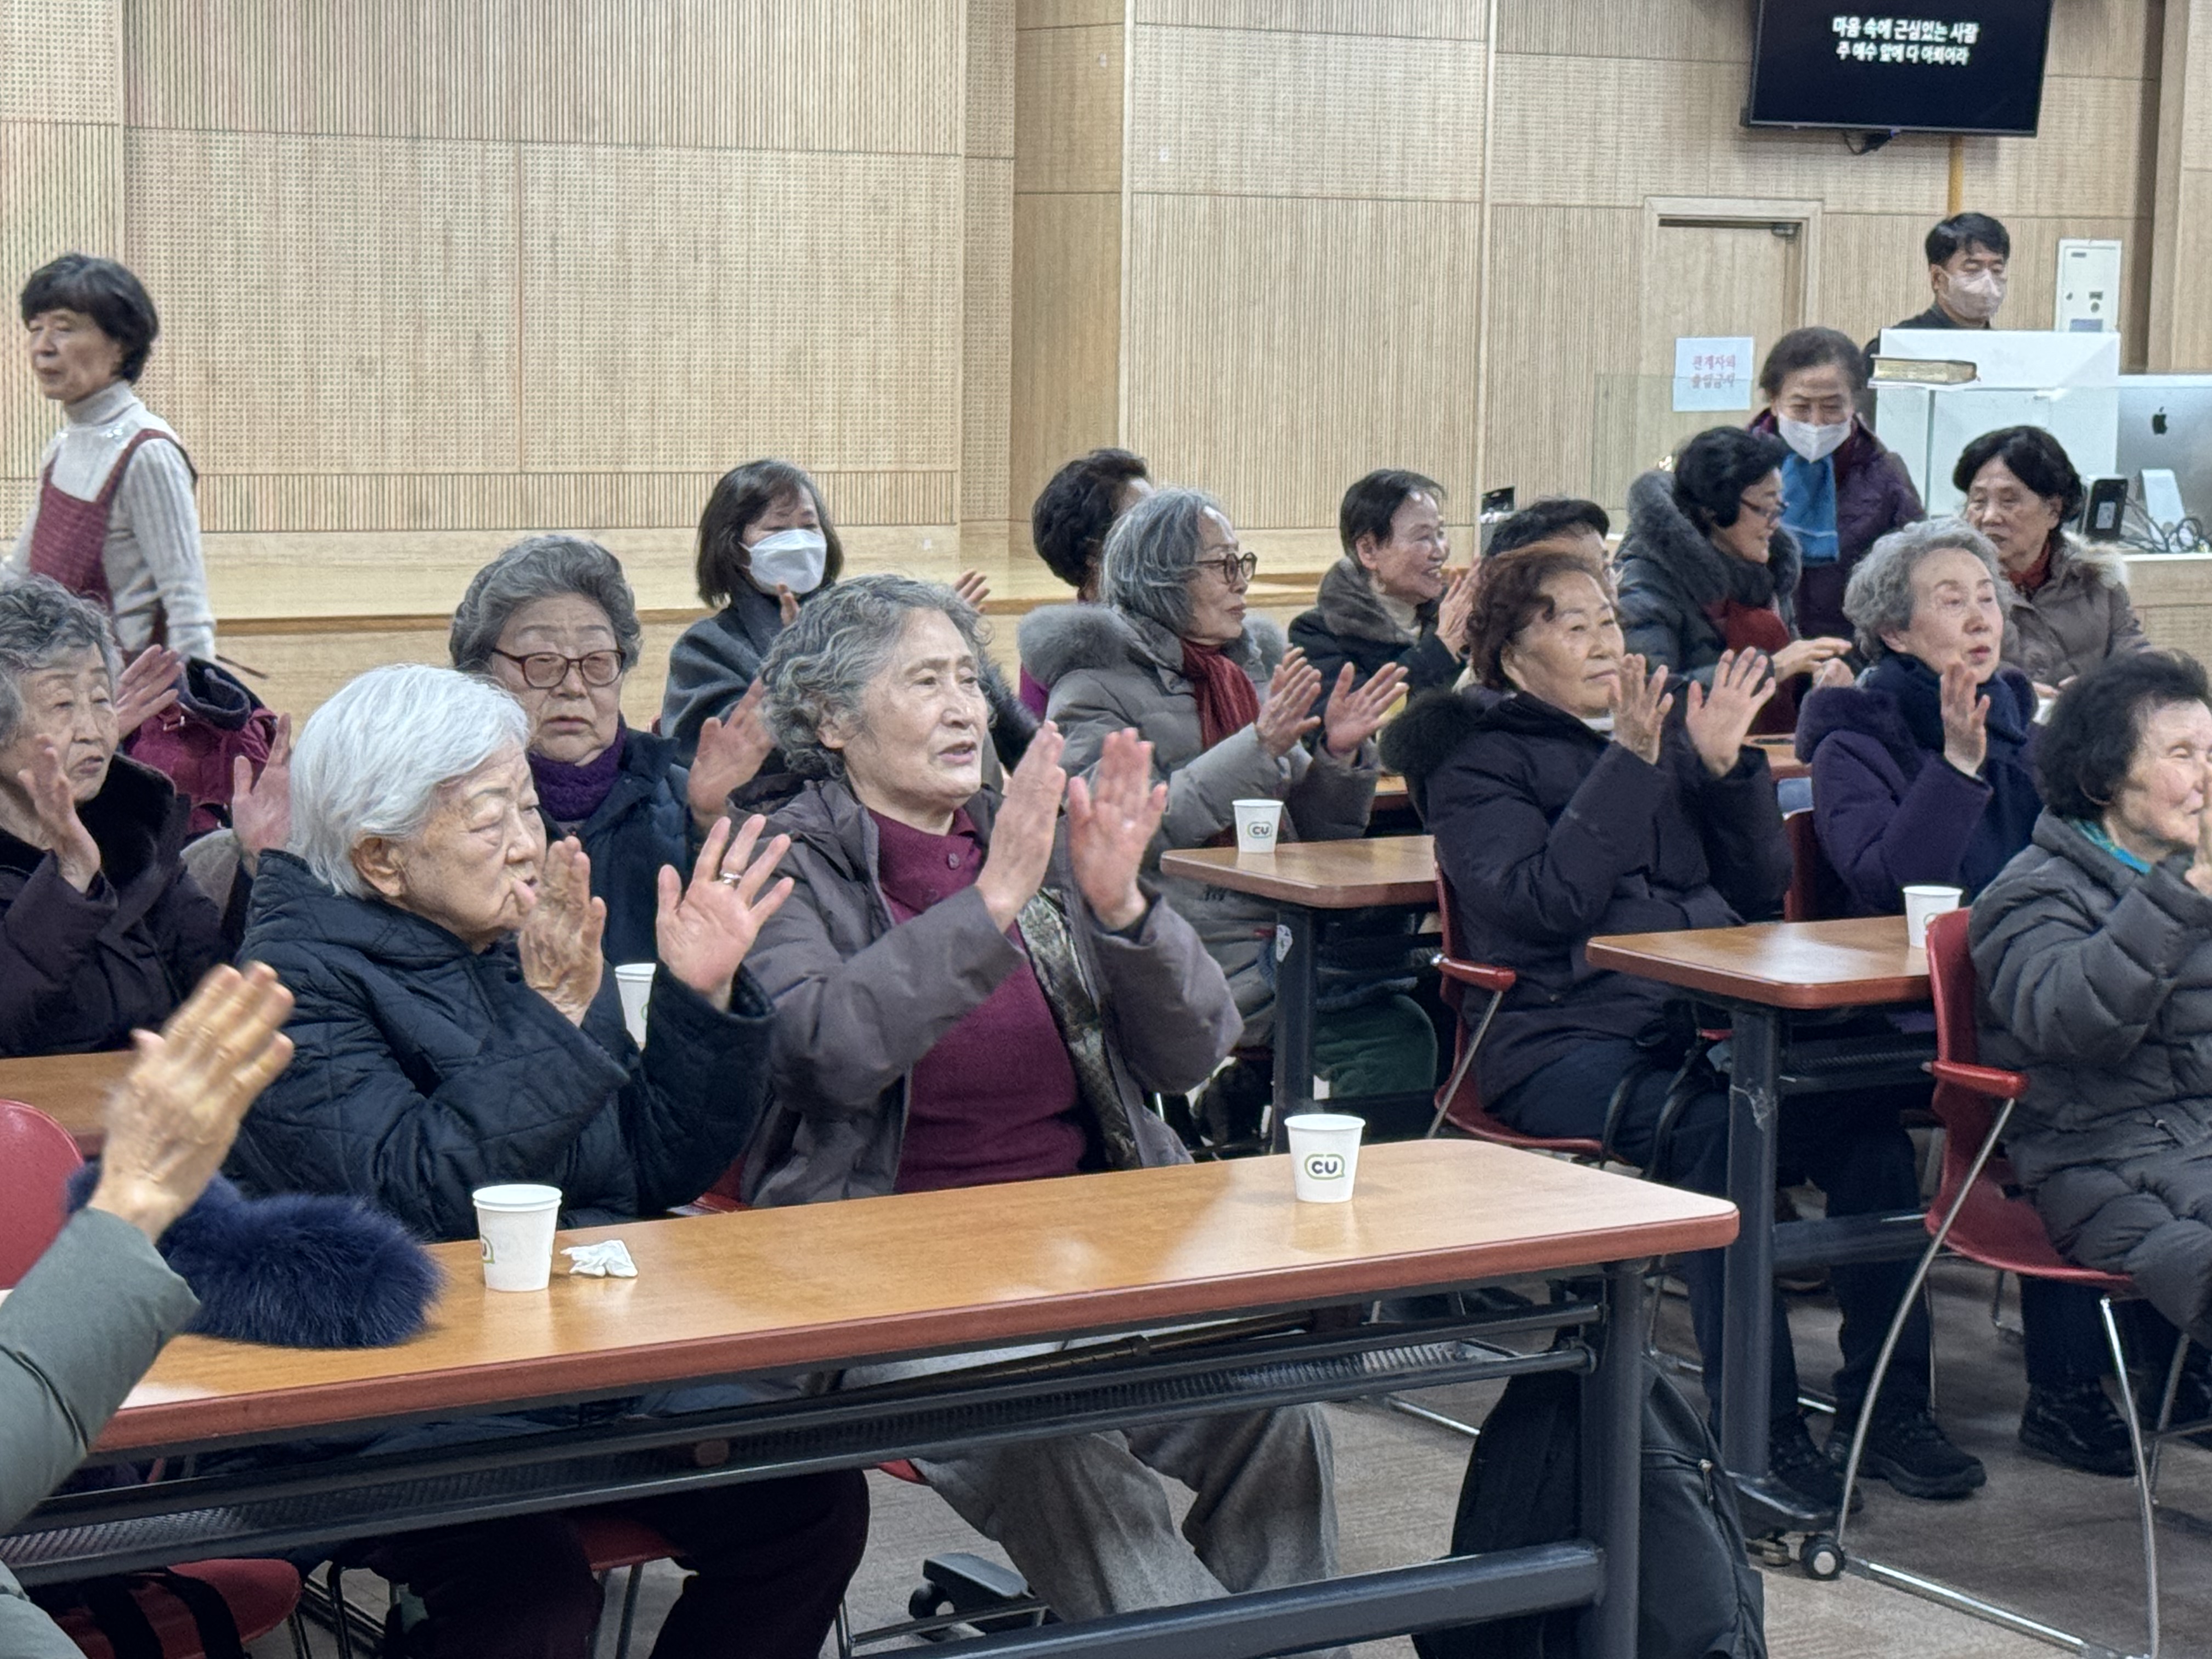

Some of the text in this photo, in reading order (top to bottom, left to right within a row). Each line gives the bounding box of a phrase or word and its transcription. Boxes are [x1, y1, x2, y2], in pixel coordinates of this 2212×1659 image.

[1832, 16, 1979, 44] 마음 속에 근심있는 사람
[1836, 41, 1970, 66] 주 예수 앞에 다 아뢰어라
[1252, 826, 1269, 834] CU
[1311, 1161, 1338, 1174] CU
